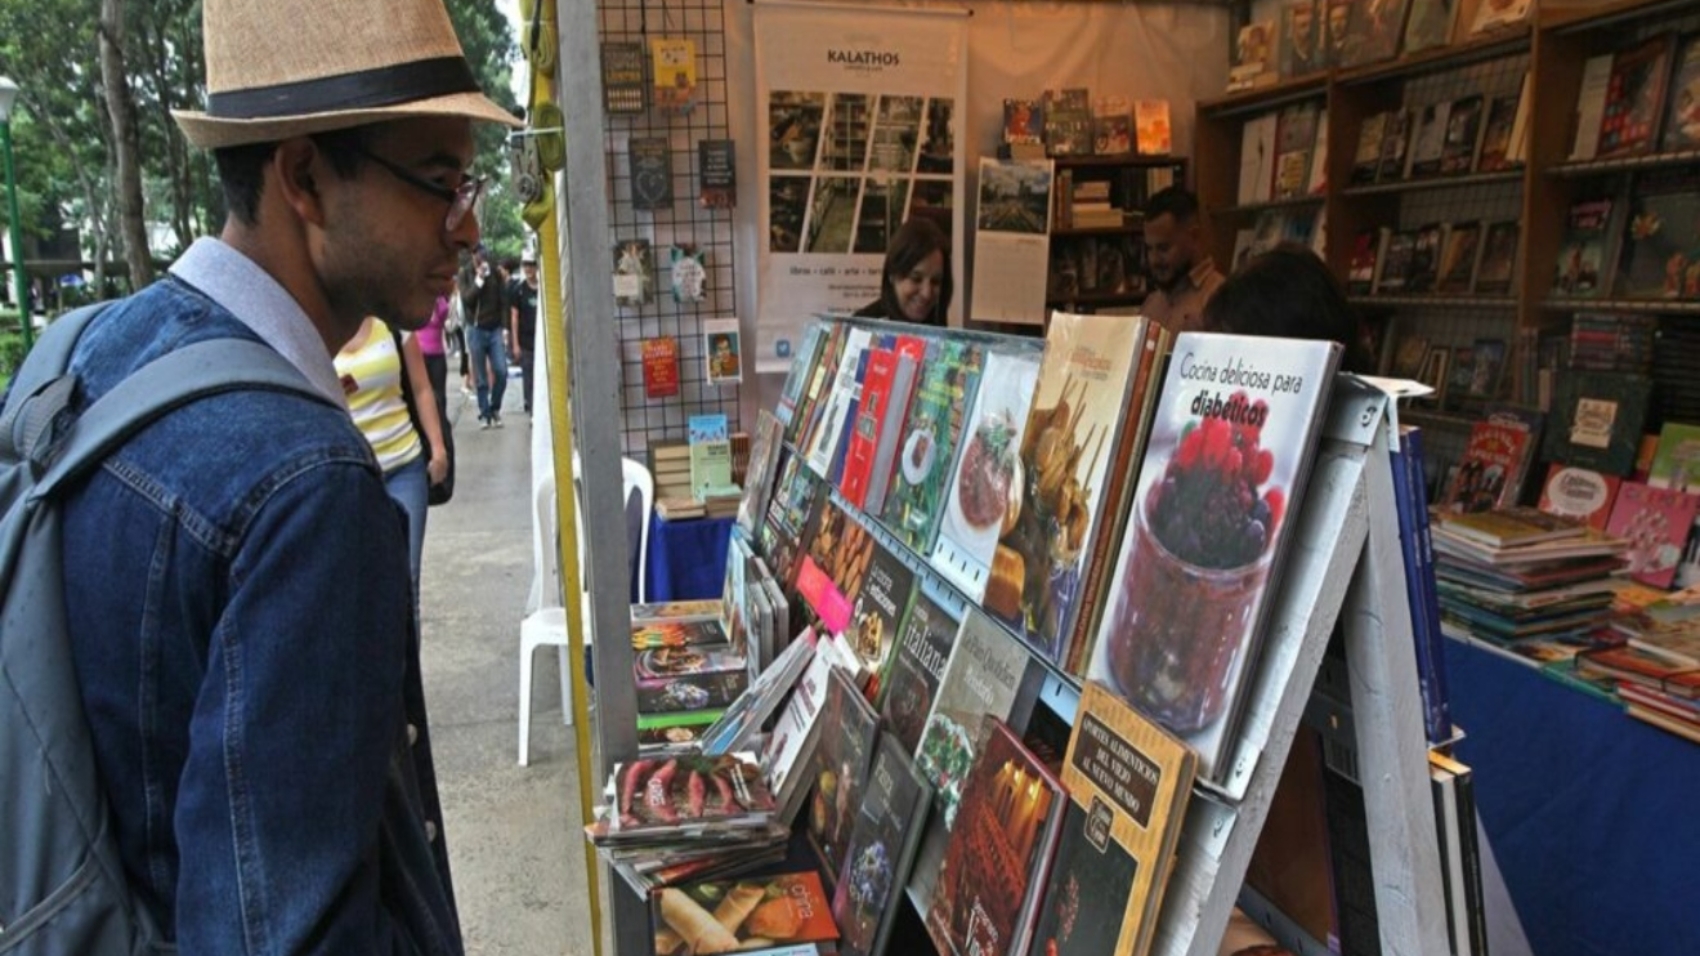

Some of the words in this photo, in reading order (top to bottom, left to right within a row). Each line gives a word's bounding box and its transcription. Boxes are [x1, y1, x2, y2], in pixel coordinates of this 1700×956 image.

[827, 49, 900, 67] KALATHOS
[1180, 351, 1218, 383] Cocina
[1220, 355, 1271, 390] deliciosa
[1271, 373, 1303, 396] para
[1190, 388, 1267, 428] diabéticos
[903, 615, 948, 681] italiana
[1113, 780, 1141, 813] MUNDO
